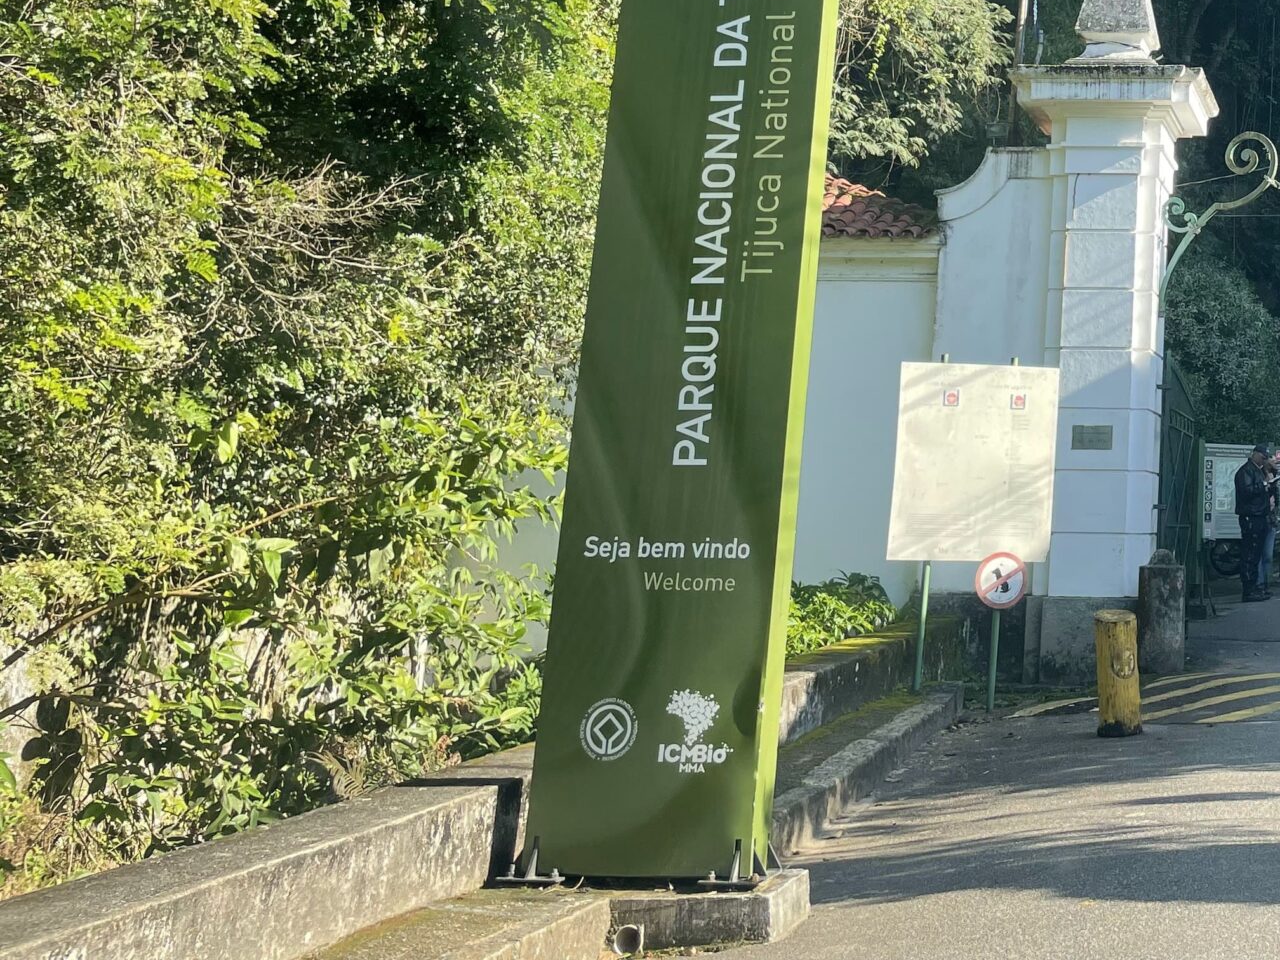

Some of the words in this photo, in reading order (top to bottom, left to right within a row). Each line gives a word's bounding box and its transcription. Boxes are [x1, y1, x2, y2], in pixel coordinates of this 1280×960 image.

[714, 15, 750, 67] DA
[753, 10, 797, 159] National
[691, 80, 744, 284] NACIONAL
[740, 174, 784, 283] Tijuca
[673, 299, 722, 466] PARQUE
[584, 536, 631, 563] Seja
[637, 537, 685, 558] bem
[692, 537, 751, 559] vindo
[643, 571, 736, 592] Welcome
[657, 743, 733, 764] ICMBio
[679, 762, 706, 773] MMA
